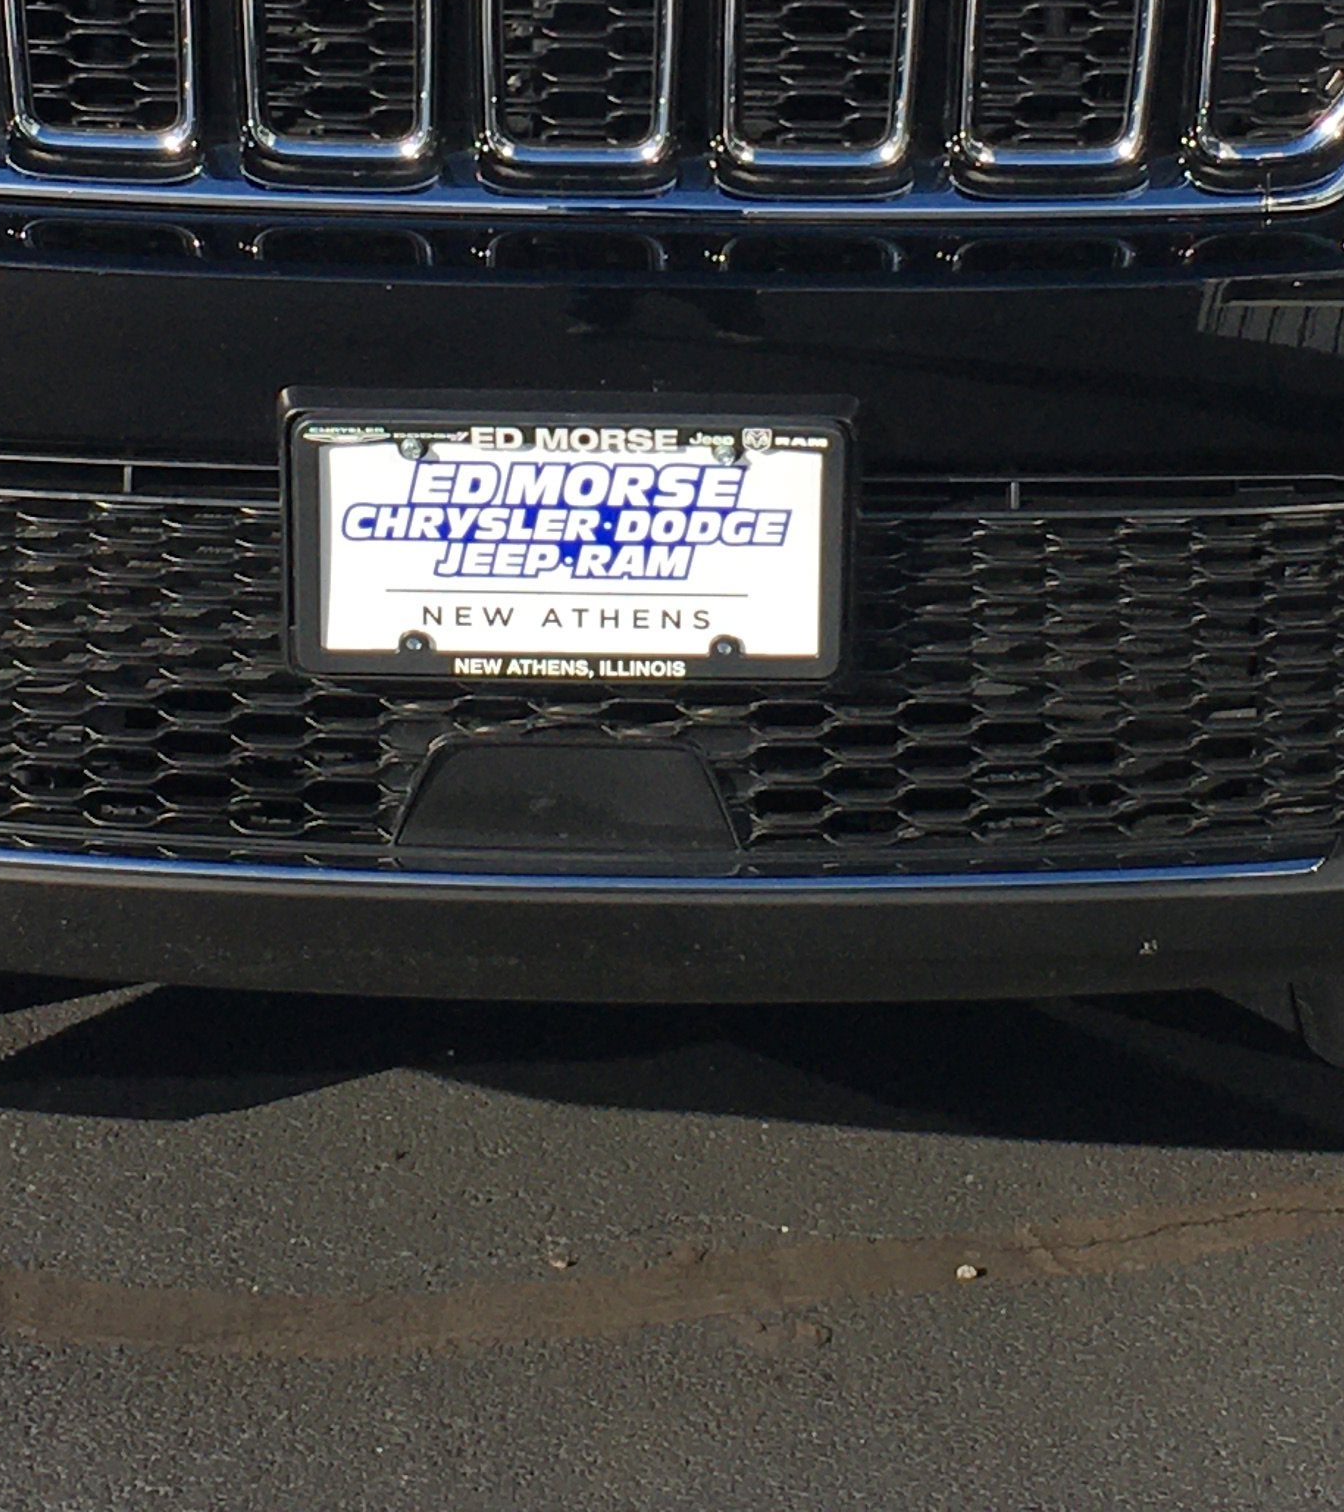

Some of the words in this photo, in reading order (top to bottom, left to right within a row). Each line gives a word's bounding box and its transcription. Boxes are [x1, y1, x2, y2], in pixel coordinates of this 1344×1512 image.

[470, 426, 523, 450] ED
[535, 427, 679, 452] MORSE
[774, 436, 829, 447] RAM
[407, 461, 500, 505] ED
[502, 461, 746, 509] MORSE
[422, 605, 514, 627] NEW
[541, 607, 711, 630] ATHENS
[454, 657, 503, 676] NEW
[506, 658, 595, 679] ATHENS,
[599, 659, 686, 677] ILLINOIS
